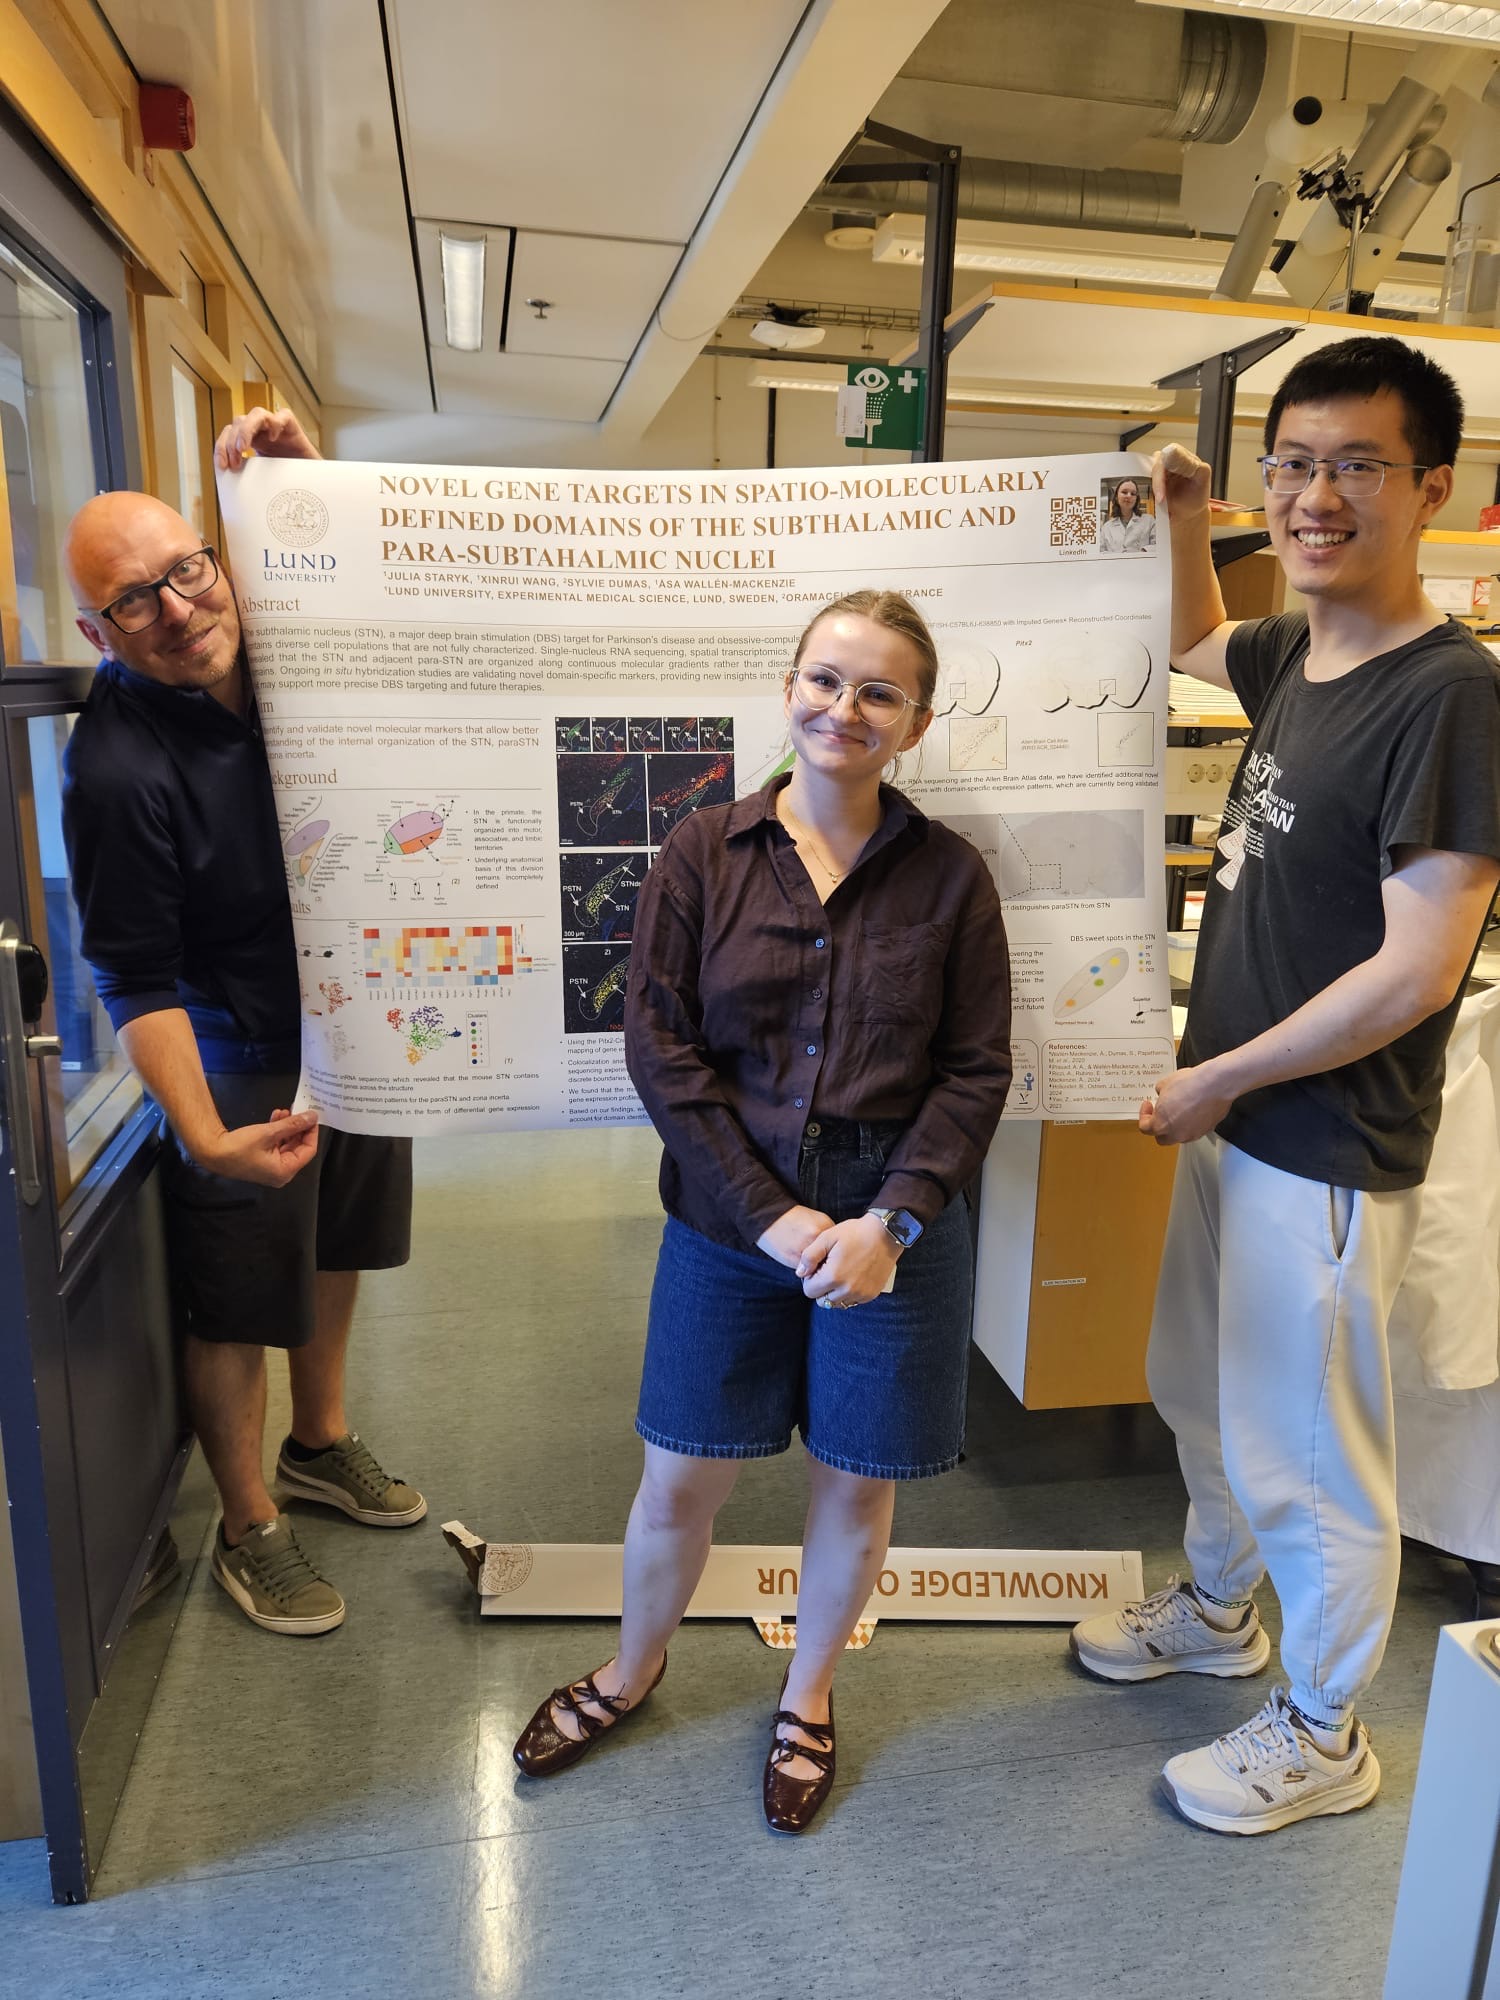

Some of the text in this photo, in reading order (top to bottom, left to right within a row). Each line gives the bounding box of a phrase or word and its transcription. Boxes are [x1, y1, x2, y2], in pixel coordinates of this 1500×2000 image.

[379, 472, 1050, 504] NOVEL GENE TARGETS IN SPATIO-MOLECULARLY
[380, 506, 1015, 536] DEFINED DOMAINS OF THE SUBTHALAMIC AND
[264, 549, 336, 570] LUND
[383, 542, 776, 569] PARA-SUBTAHALMIC NUCLEI
[264, 571, 336, 583] UNIVERSITY
[424, 573, 472, 584] STARYK,
[522, 577, 559, 587] WANG,
[608, 579, 651, 588] DUMAS,
[683, 579, 795, 588] WALLÉN-MACKENZIE
[424, 588, 494, 599] UNIVERSITY,
[497, 591, 583, 601] EXPERIMENTAL
[586, 593, 636, 602] MEDICAL
[638, 594, 689, 603] SCIENCE,
[693, 594, 725, 603] LUND,
[729, 594, 778, 603] SWEDEN,
[242, 597, 301, 613] Abstract
[255, 626, 311, 636] subthalamic
[313, 627, 351, 636] nucleus
[354, 628, 386, 639] (STN),
[398, 631, 425, 640] major
[428, 631, 452, 641] deep
[454, 632, 478, 640] brain
[480, 633, 530, 642] stimulation
[533, 633, 561, 644] (DBS)
[563, 635, 590, 644] target
[592, 634, 604, 643] for
[607, 635, 658, 644] Parkinson's
[660, 635, 695, 644] disease
[698, 636, 715, 644] and
[275, 640, 311, 648] diverse
[313, 640, 330, 648] cell
[333, 641, 389, 651] populations
[392, 642, 410, 651] that
[432, 644, 448, 652] not
[450, 643, 470, 654] fully
[472, 645, 537, 654] characterized.
[540, 646, 607, 656] Single-nucleus
[609, 647, 632, 655] RNA
[633, 648, 687, 658] sequencing,
[689, 648, 719, 657] spatial
[721, 648, 790, 657] transcriptomics,
[278, 653, 297, 662] that
[301, 652, 317, 662] the
[322, 652, 344, 662] STN
[349, 654, 368, 662] and
[372, 654, 413, 665] adjacent
[417, 656, 463, 665] para-STN
[488, 658, 534, 667] organized
[538, 658, 563, 668] along
[567, 660, 616, 668] continuous
[621, 660, 664, 668] molecular
[668, 660, 710, 670] gradients
[713, 660, 739, 668] rather
[743, 659, 763, 668] than
[279, 666, 320, 677] Ongoing
[323, 666, 332, 674] in
[335, 666, 353, 675] situ
[355, 667, 415, 677] hybridization
[417, 668, 452, 677] studies
[472, 669, 517, 680] validating
[519, 670, 544, 679] novel
[546, 670, 617, 680] domain-specific
[619, 672, 658, 680] markers,
[660, 671, 700, 682] providing
[723, 672, 759, 682] insights
[759, 671, 776, 680] into
[277, 680, 314, 689] support
[316, 680, 341, 688] more
[343, 680, 379, 689] precise
[381, 679, 404, 688] DBS
[406, 681, 447, 691] targeting
[450, 681, 468, 690] and
[470, 682, 497, 690] future
[499, 682, 544, 692] therapies.
[286, 724, 539, 735] and validate novel molecular markers that allow better
[306, 737, 316, 746] of
[319, 737, 335, 746] the
[338, 737, 374, 746] internal
[377, 737, 435, 747] organization
[438, 737, 448, 746] of
[451, 738, 467, 746] the
[469, 737, 494, 747] STN,
[498, 737, 539, 747] paraSTN
[272, 769, 337, 789] ckground
[758, 1568, 798, 1595] UR
[911, 1570, 1109, 1598] KNOWLEDGE
